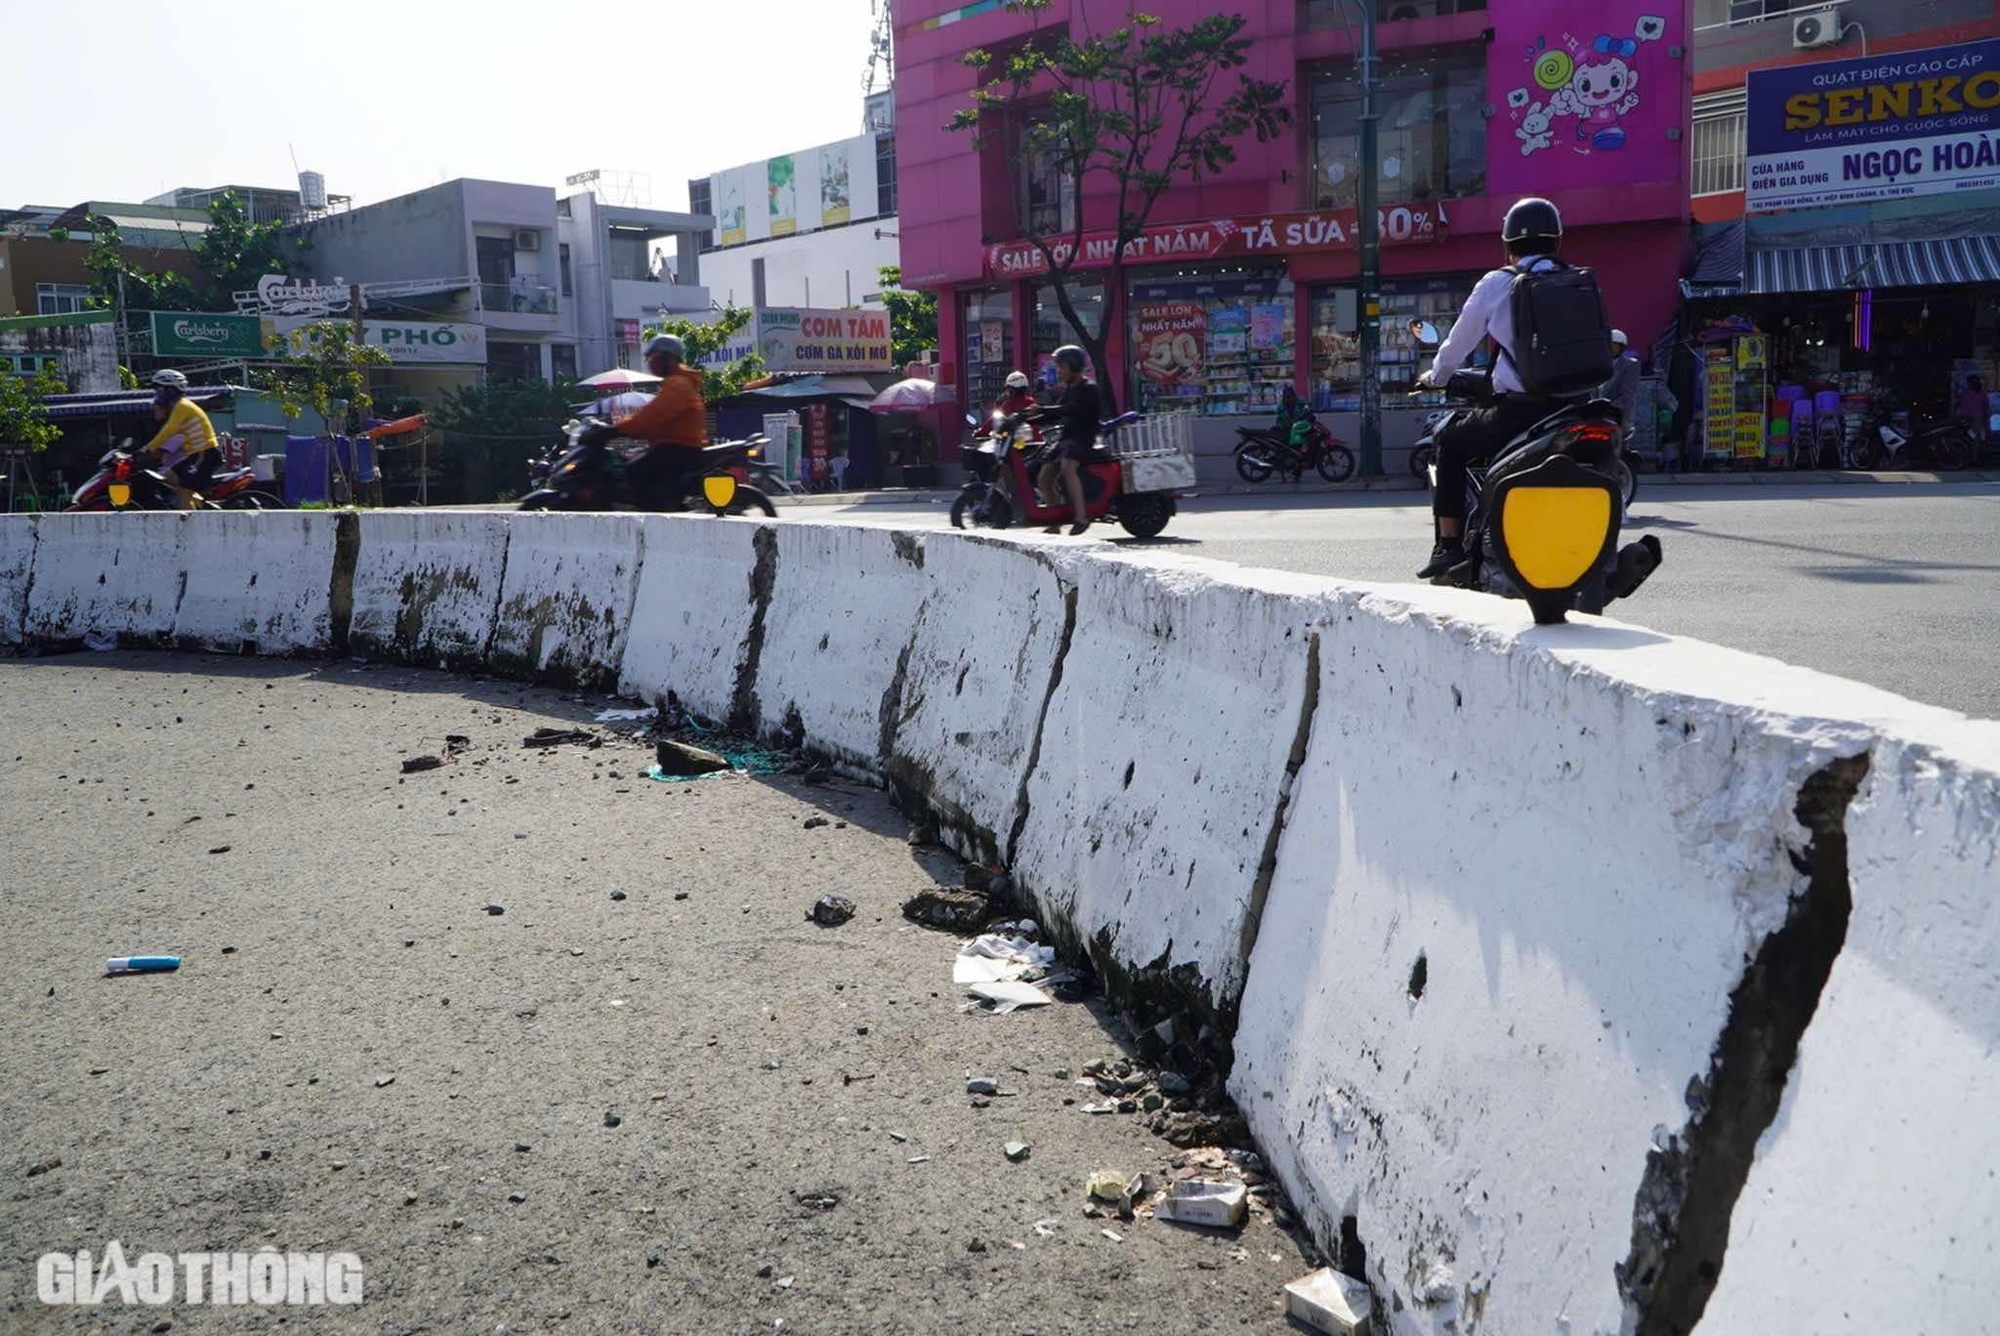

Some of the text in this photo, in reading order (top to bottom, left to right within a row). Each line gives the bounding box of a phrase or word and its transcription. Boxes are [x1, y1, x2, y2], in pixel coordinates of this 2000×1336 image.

[1862, 65, 1901, 81] ĐIỆN
[1905, 61, 1941, 74] CAO
[1945, 54, 1984, 69] CẤP
[1785, 71, 2000, 130] SENKO
[1870, 123, 1899, 135] CHO
[1752, 159, 1805, 176] CỬA HÀNG
[1843, 132, 2000, 183] NGỌC HOÀ
[1752, 172, 1829, 190] ĐIỆN GIA DỤNG
[1001, 248, 1041, 273] SALE
[1154, 227, 1210, 254] NĂM
[1241, 218, 1277, 249] TÃ
[1286, 214, 1346, 246] SỮA
[1141, 306, 1169, 317] SALE
[174, 320, 229, 342] Carlsberg
[381, 325, 457, 345] PHỐ
[848, 314, 885, 338] TẤM
[796, 344, 823, 360] CƠM
